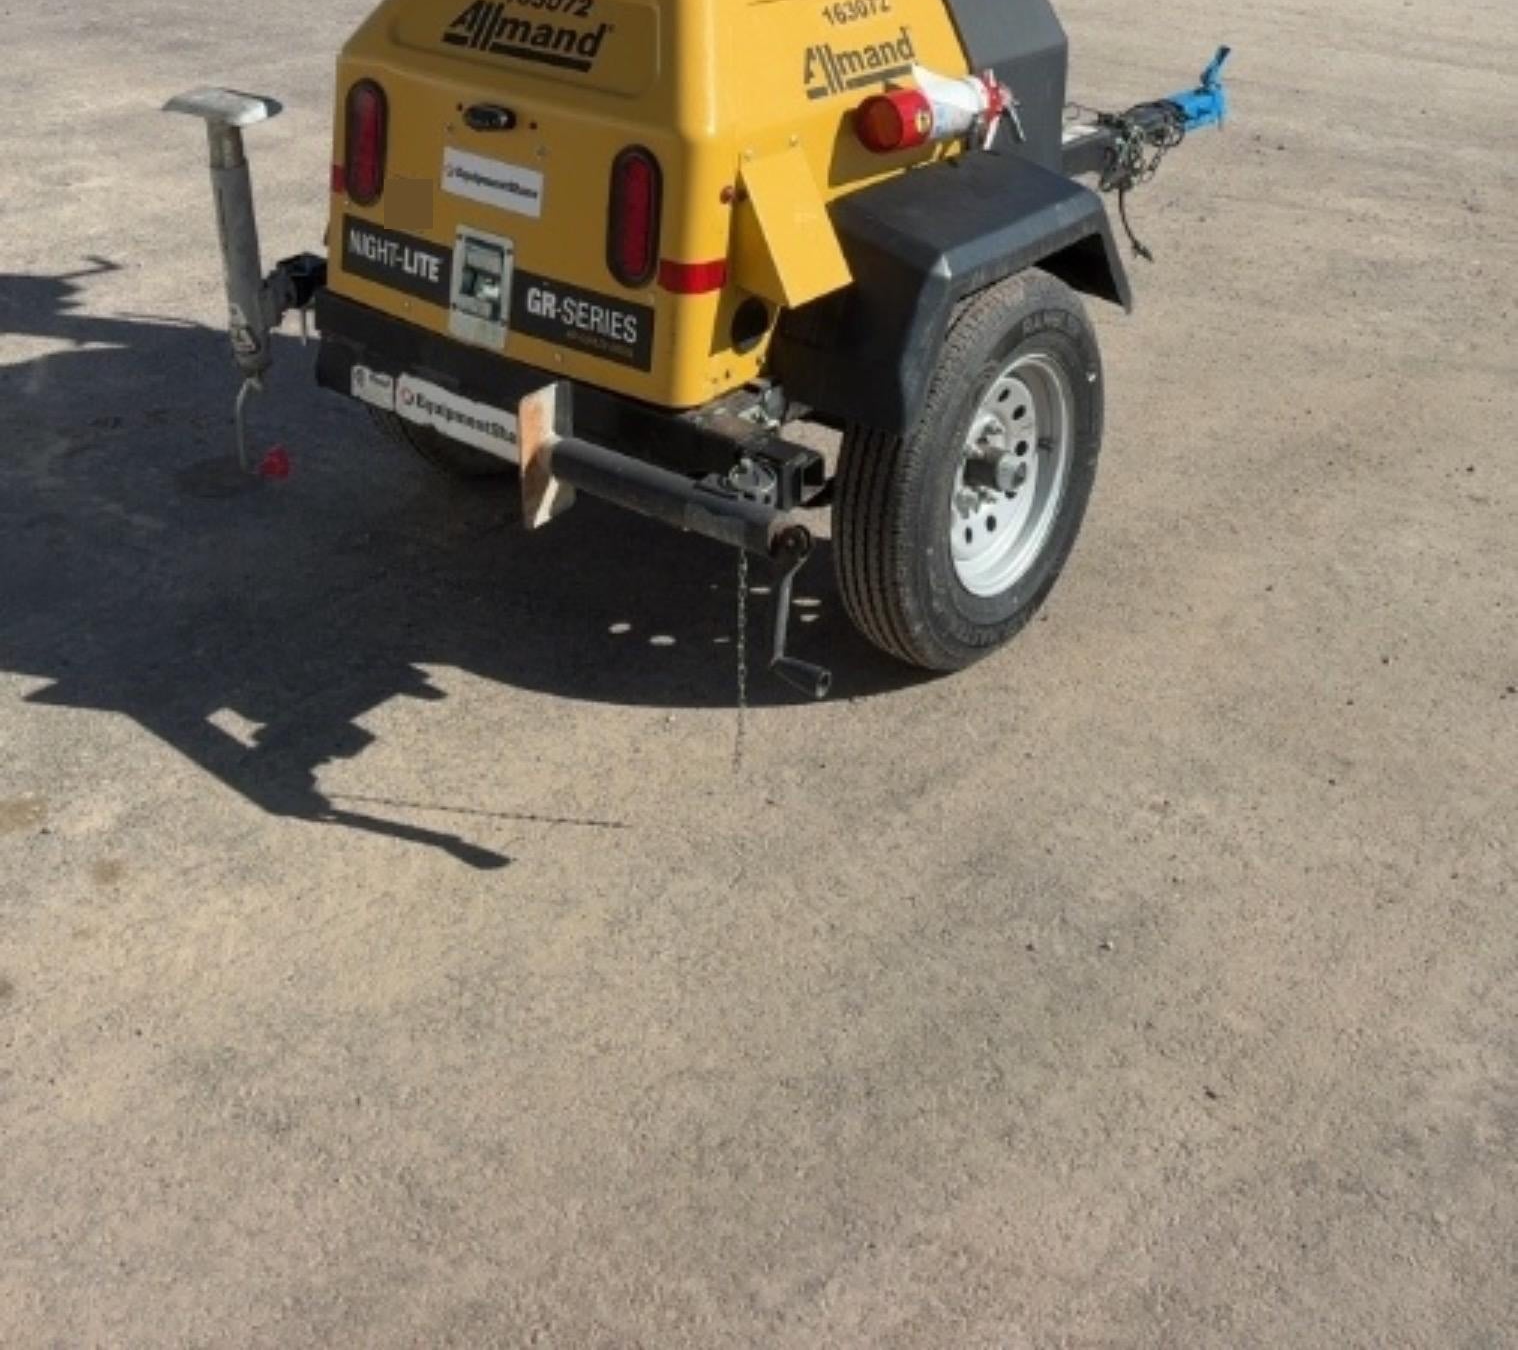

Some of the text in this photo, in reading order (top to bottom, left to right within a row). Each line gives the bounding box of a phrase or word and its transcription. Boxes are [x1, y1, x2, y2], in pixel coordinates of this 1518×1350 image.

[803, 26, 915, 94] Allmand
[349, 228, 442, 283] NIGHT-LITE
[526, 286, 638, 344] GR-SERIES
[416, 392, 517, 445] EquipmentSha
